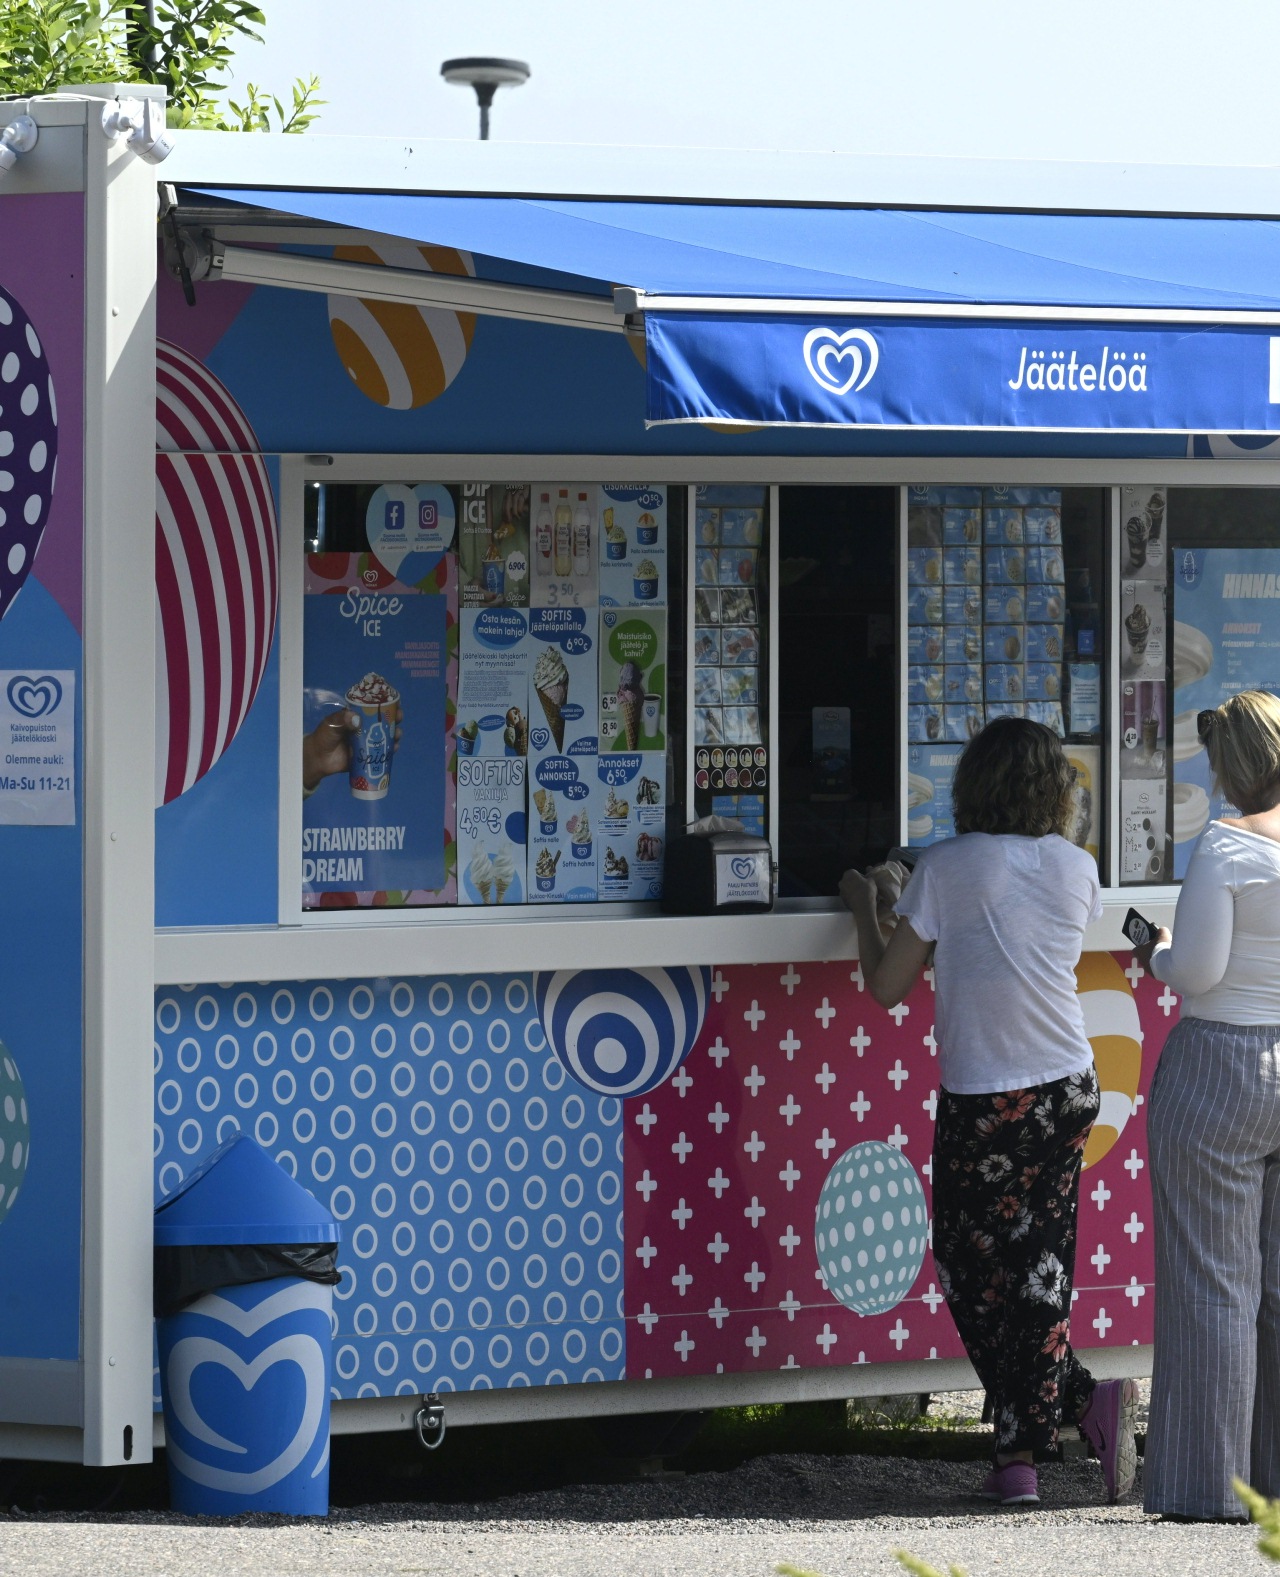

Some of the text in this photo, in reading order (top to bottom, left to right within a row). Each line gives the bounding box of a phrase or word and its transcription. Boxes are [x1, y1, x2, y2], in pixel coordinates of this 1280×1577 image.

[1008, 345, 1149, 393] Jäätelöä
[463, 500, 487, 524] ICE
[340, 585, 404, 624] Spice
[481, 613, 521, 625] Osta kesän
[541, 609, 572, 621] SOFTIS
[363, 619, 381, 637] ICE
[478, 626, 526, 638] makein lahja!
[617, 632, 652, 641] Maistuisiko
[620, 640, 642, 651] jäätelö
[624, 649, 645, 657] kahvi?
[10, 723, 57, 734] Kaivopuiston
[11, 733, 58, 745] jäätelökioski
[5, 754, 64, 766] Olemme auki:
[544, 760, 570, 770] SOFTIS
[598, 757, 640, 768] Annokset
[459, 759, 524, 787] SOFTIS
[538, 771, 577, 781] ANNOKSET
[0, 776, 71, 791] Ma-Su 11-21
[473, 788, 509, 804] VANILJA
[302, 826, 406, 852] STRAWBERRY
[302, 857, 364, 883] DREAM
